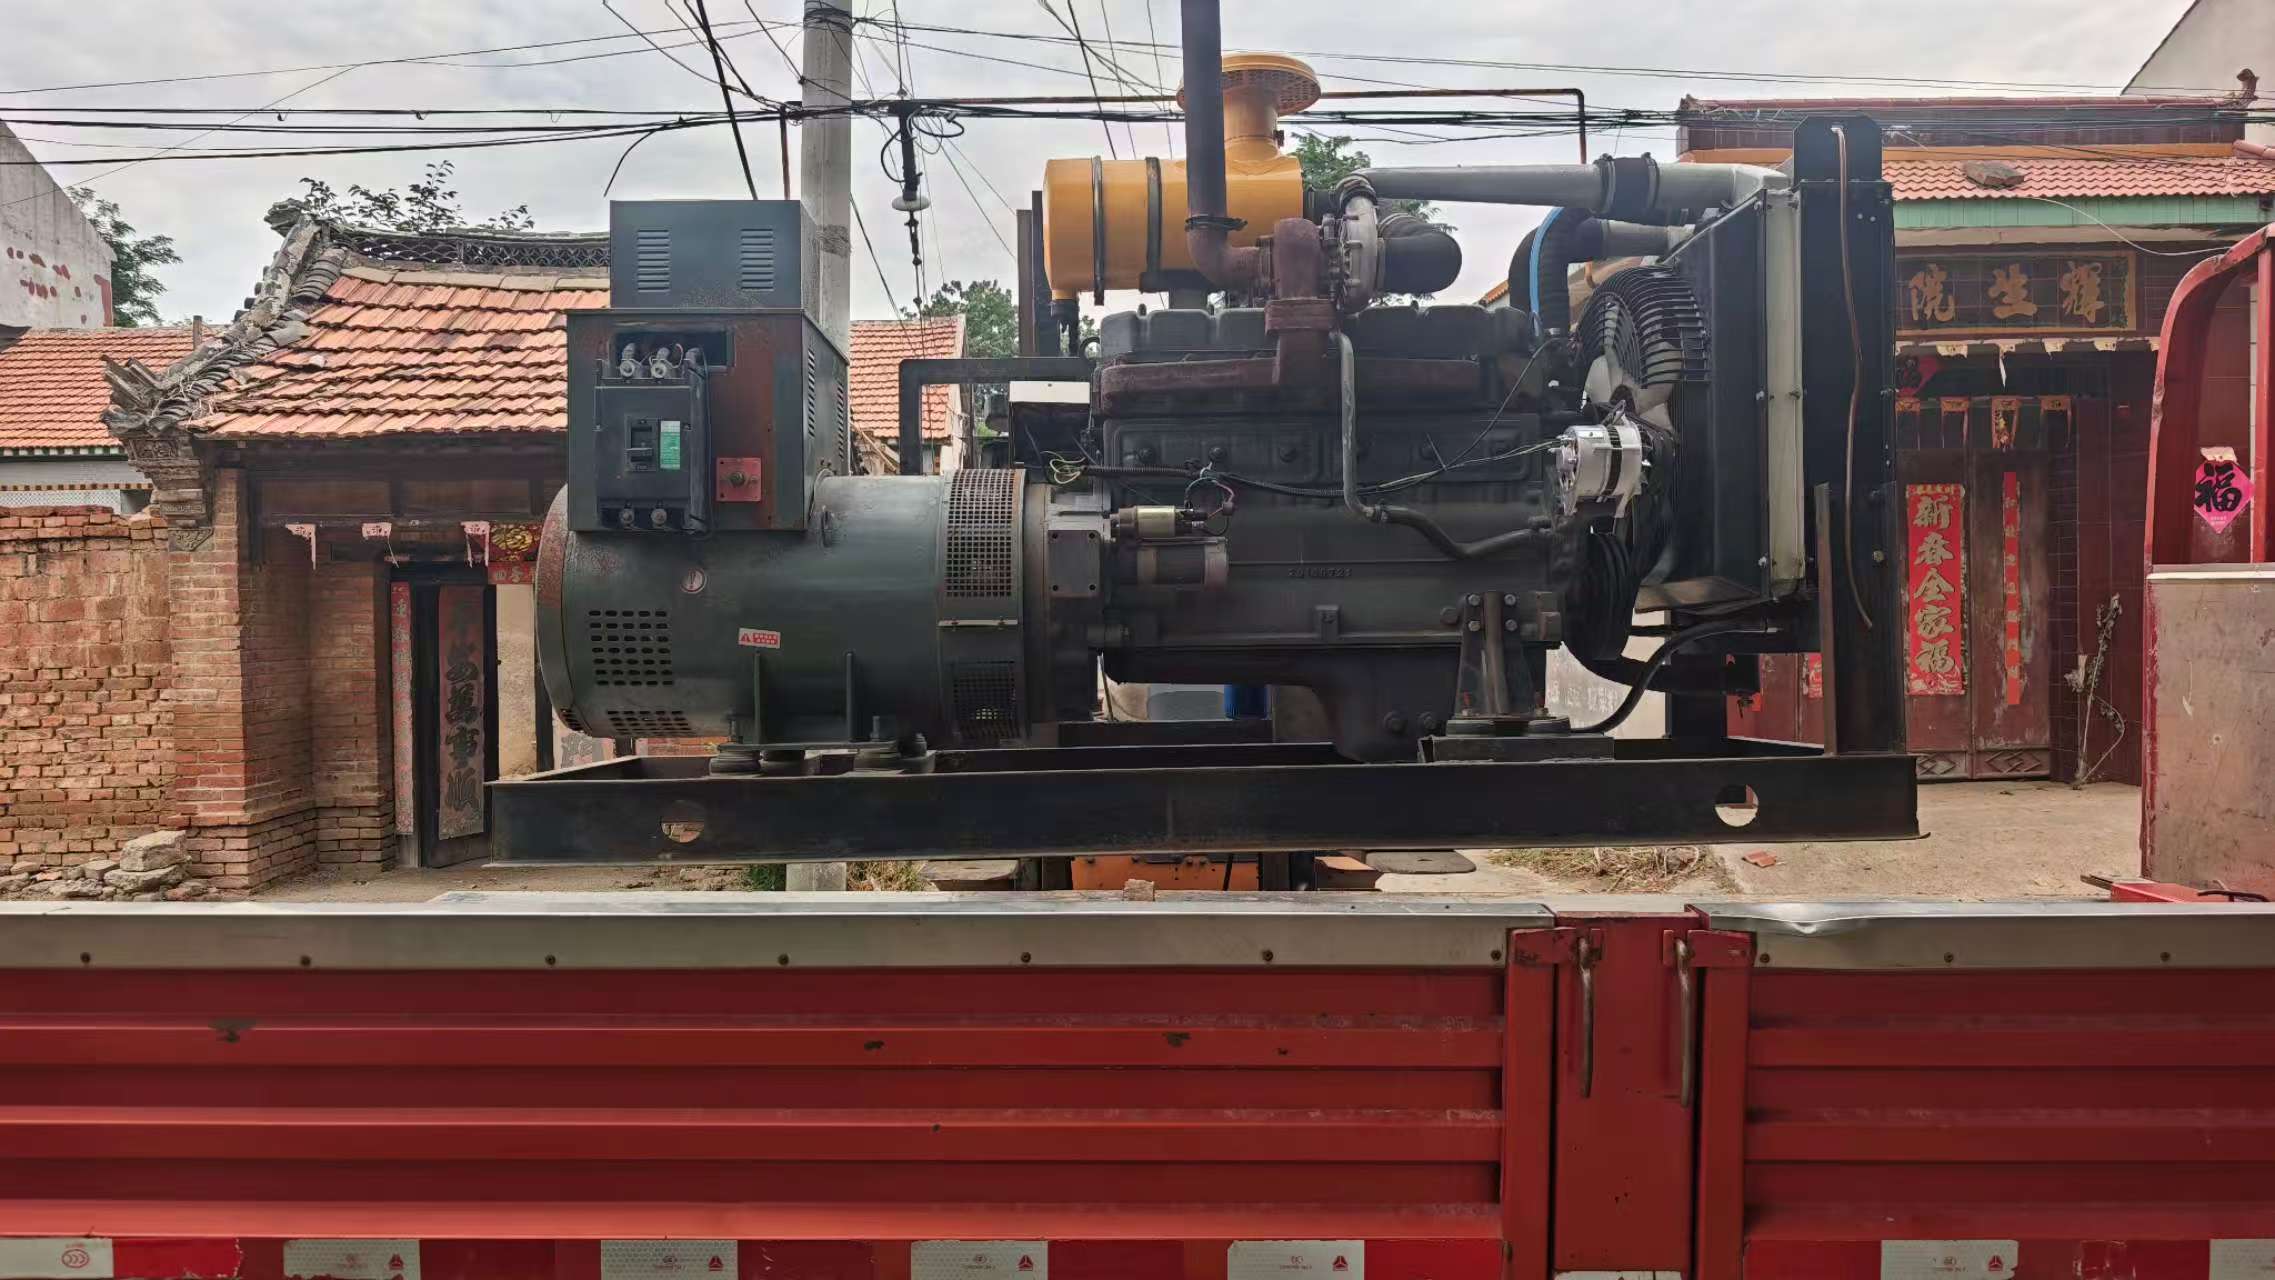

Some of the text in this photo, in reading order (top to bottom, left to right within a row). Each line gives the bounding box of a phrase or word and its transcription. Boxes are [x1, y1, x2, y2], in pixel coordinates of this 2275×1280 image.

[2194, 463, 2242, 512] 福
[1913, 495, 1955, 673] 新春全家福
